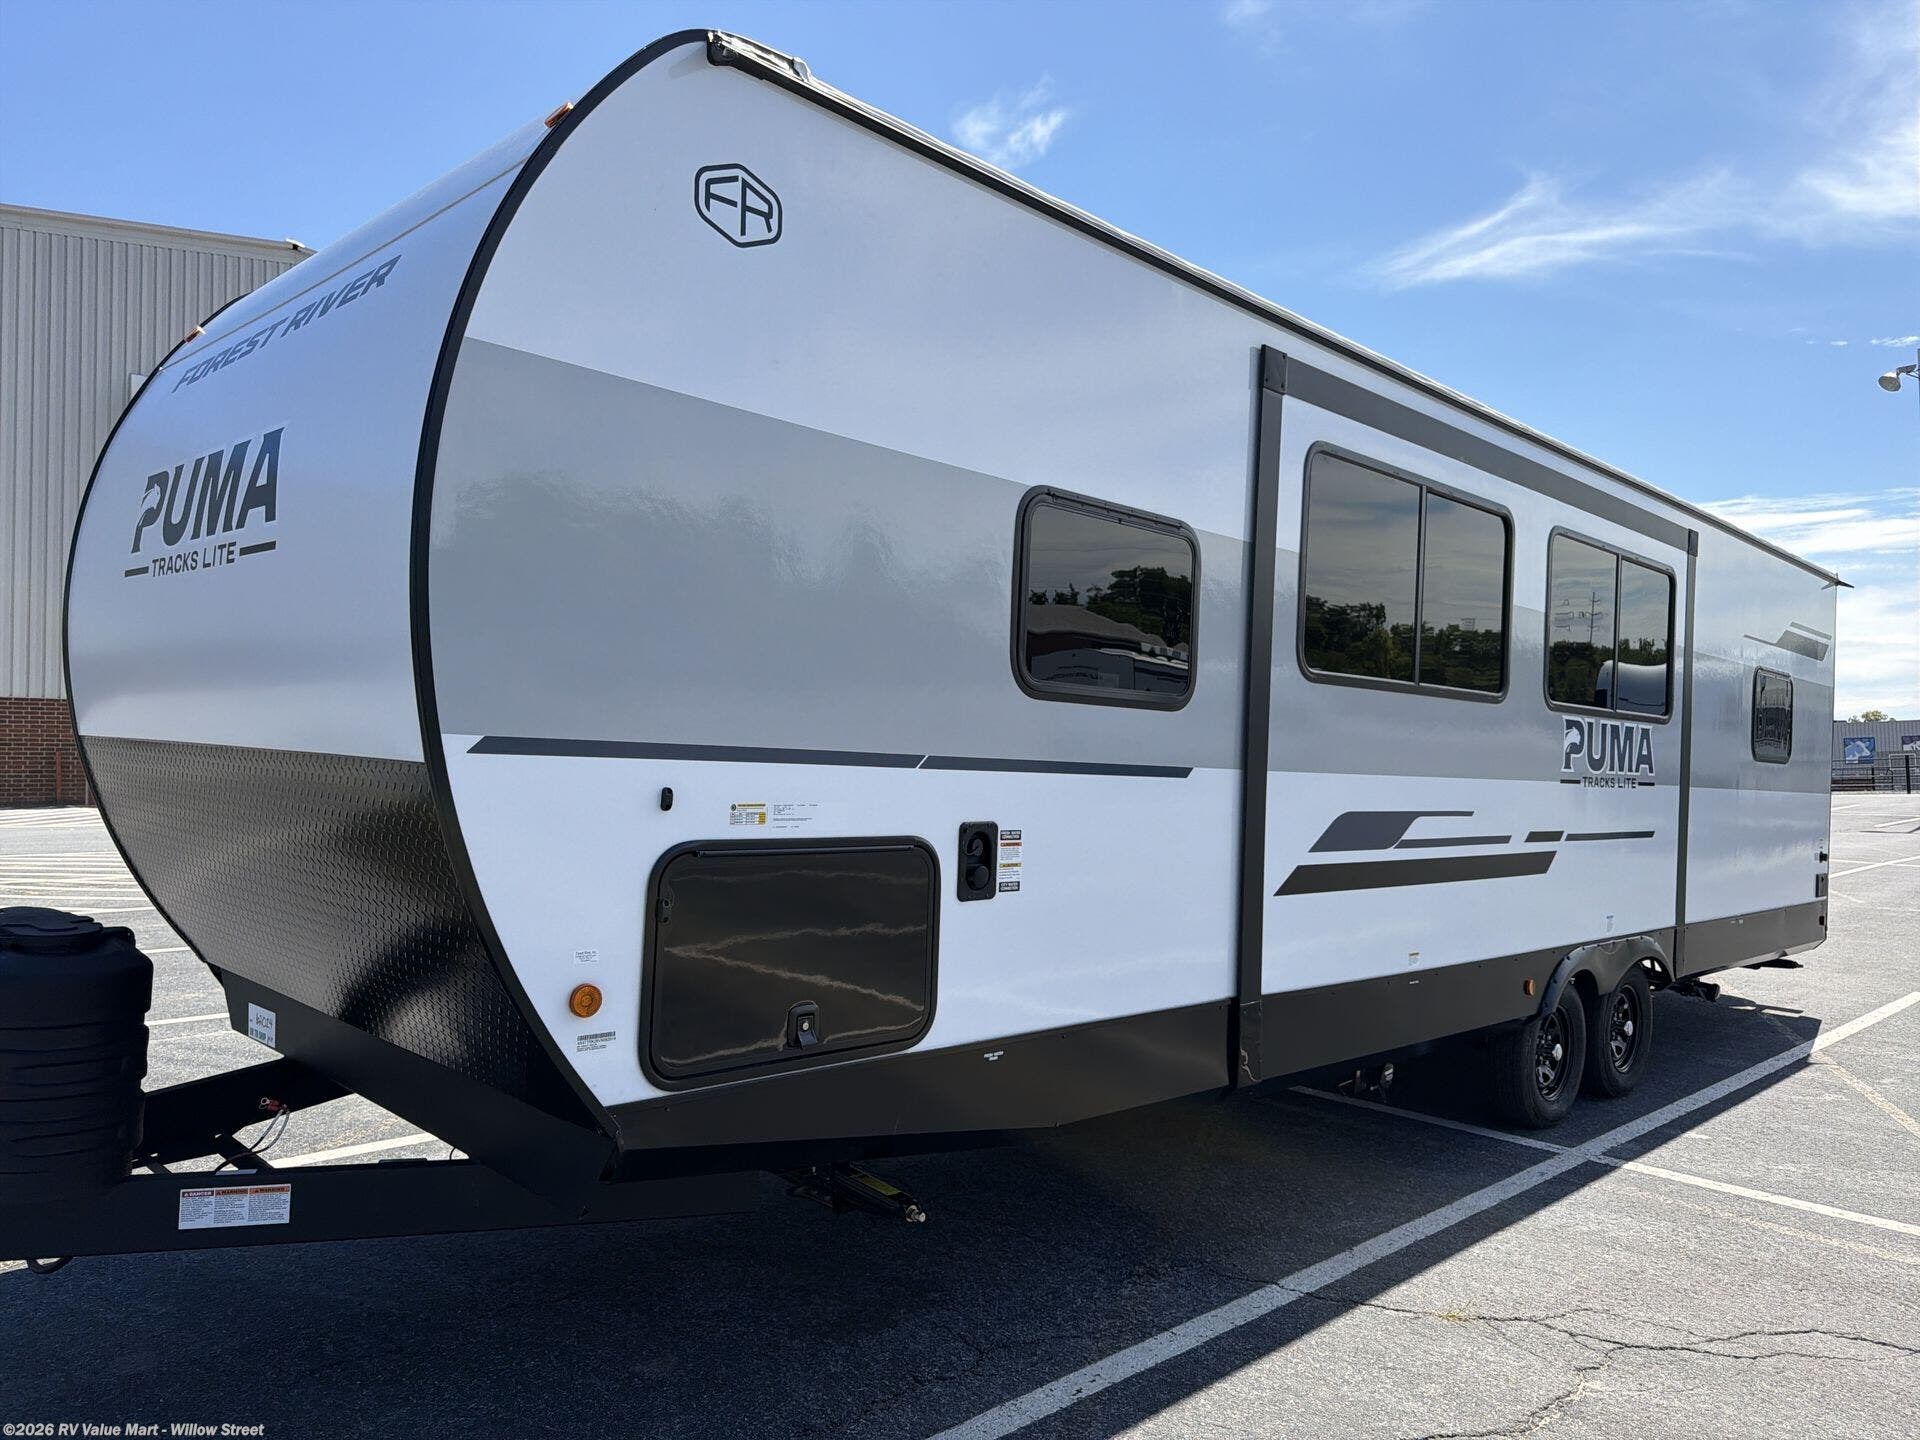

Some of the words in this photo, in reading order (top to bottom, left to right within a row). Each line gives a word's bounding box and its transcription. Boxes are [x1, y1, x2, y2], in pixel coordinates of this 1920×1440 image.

[171, 317, 290, 394] FOREST
[280, 254, 402, 338] RIVER
[130, 426, 285, 554] PUMA
[151, 550, 198, 578] TRACKS
[203, 541, 236, 569] LITE
[1562, 717, 1655, 775] PUMA
[1582, 776, 1616, 789] TRACKS
[1618, 777, 1637, 789] LITE
